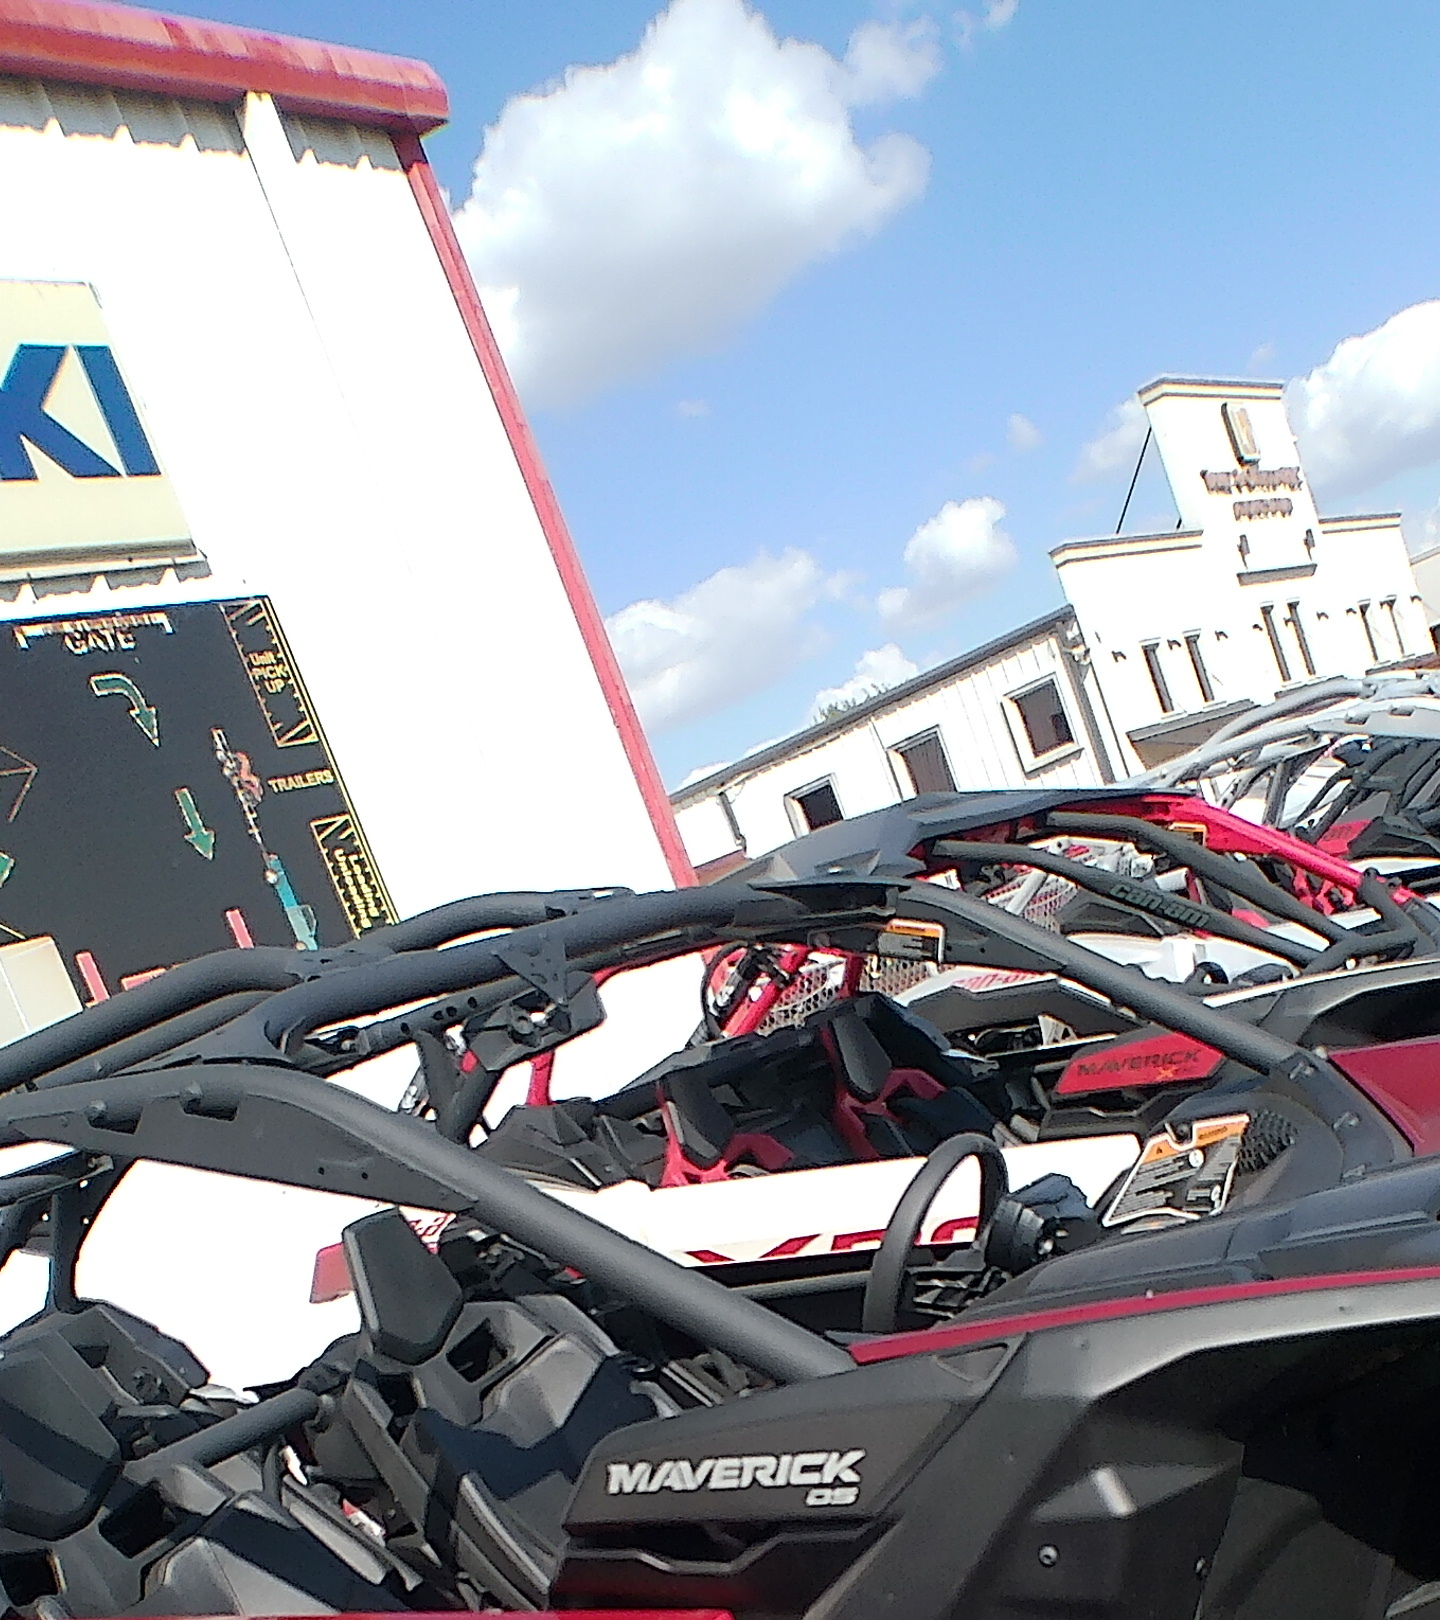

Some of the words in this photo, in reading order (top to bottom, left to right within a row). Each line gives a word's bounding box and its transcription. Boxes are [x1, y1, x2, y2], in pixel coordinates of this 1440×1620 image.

[265, 679, 286, 694] UP
[268, 769, 335, 793] TRAILERS
[608, 1448, 865, 1495] MAVERICK
